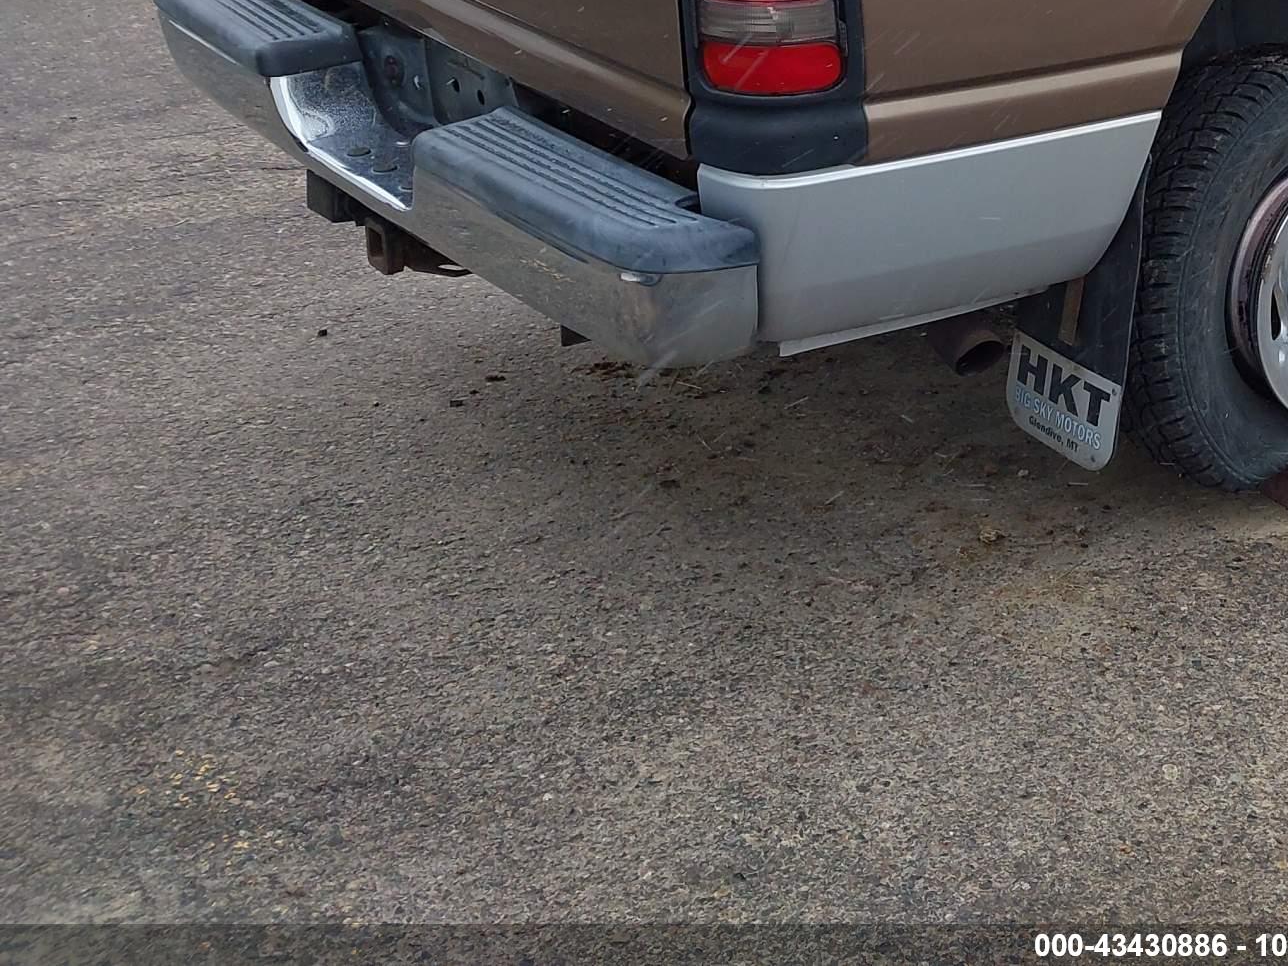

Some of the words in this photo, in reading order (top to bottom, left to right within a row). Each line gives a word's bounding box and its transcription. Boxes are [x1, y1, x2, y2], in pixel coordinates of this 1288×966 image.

[1015, 384, 1031, 408] BIG
[1033, 398, 1054, 421] SKY
[1055, 410, 1101, 450] MOTORS
[1017, 344, 1112, 427] HKT
[1028, 415, 1065, 446] Glendive,
[1066, 437, 1079, 453] MT
